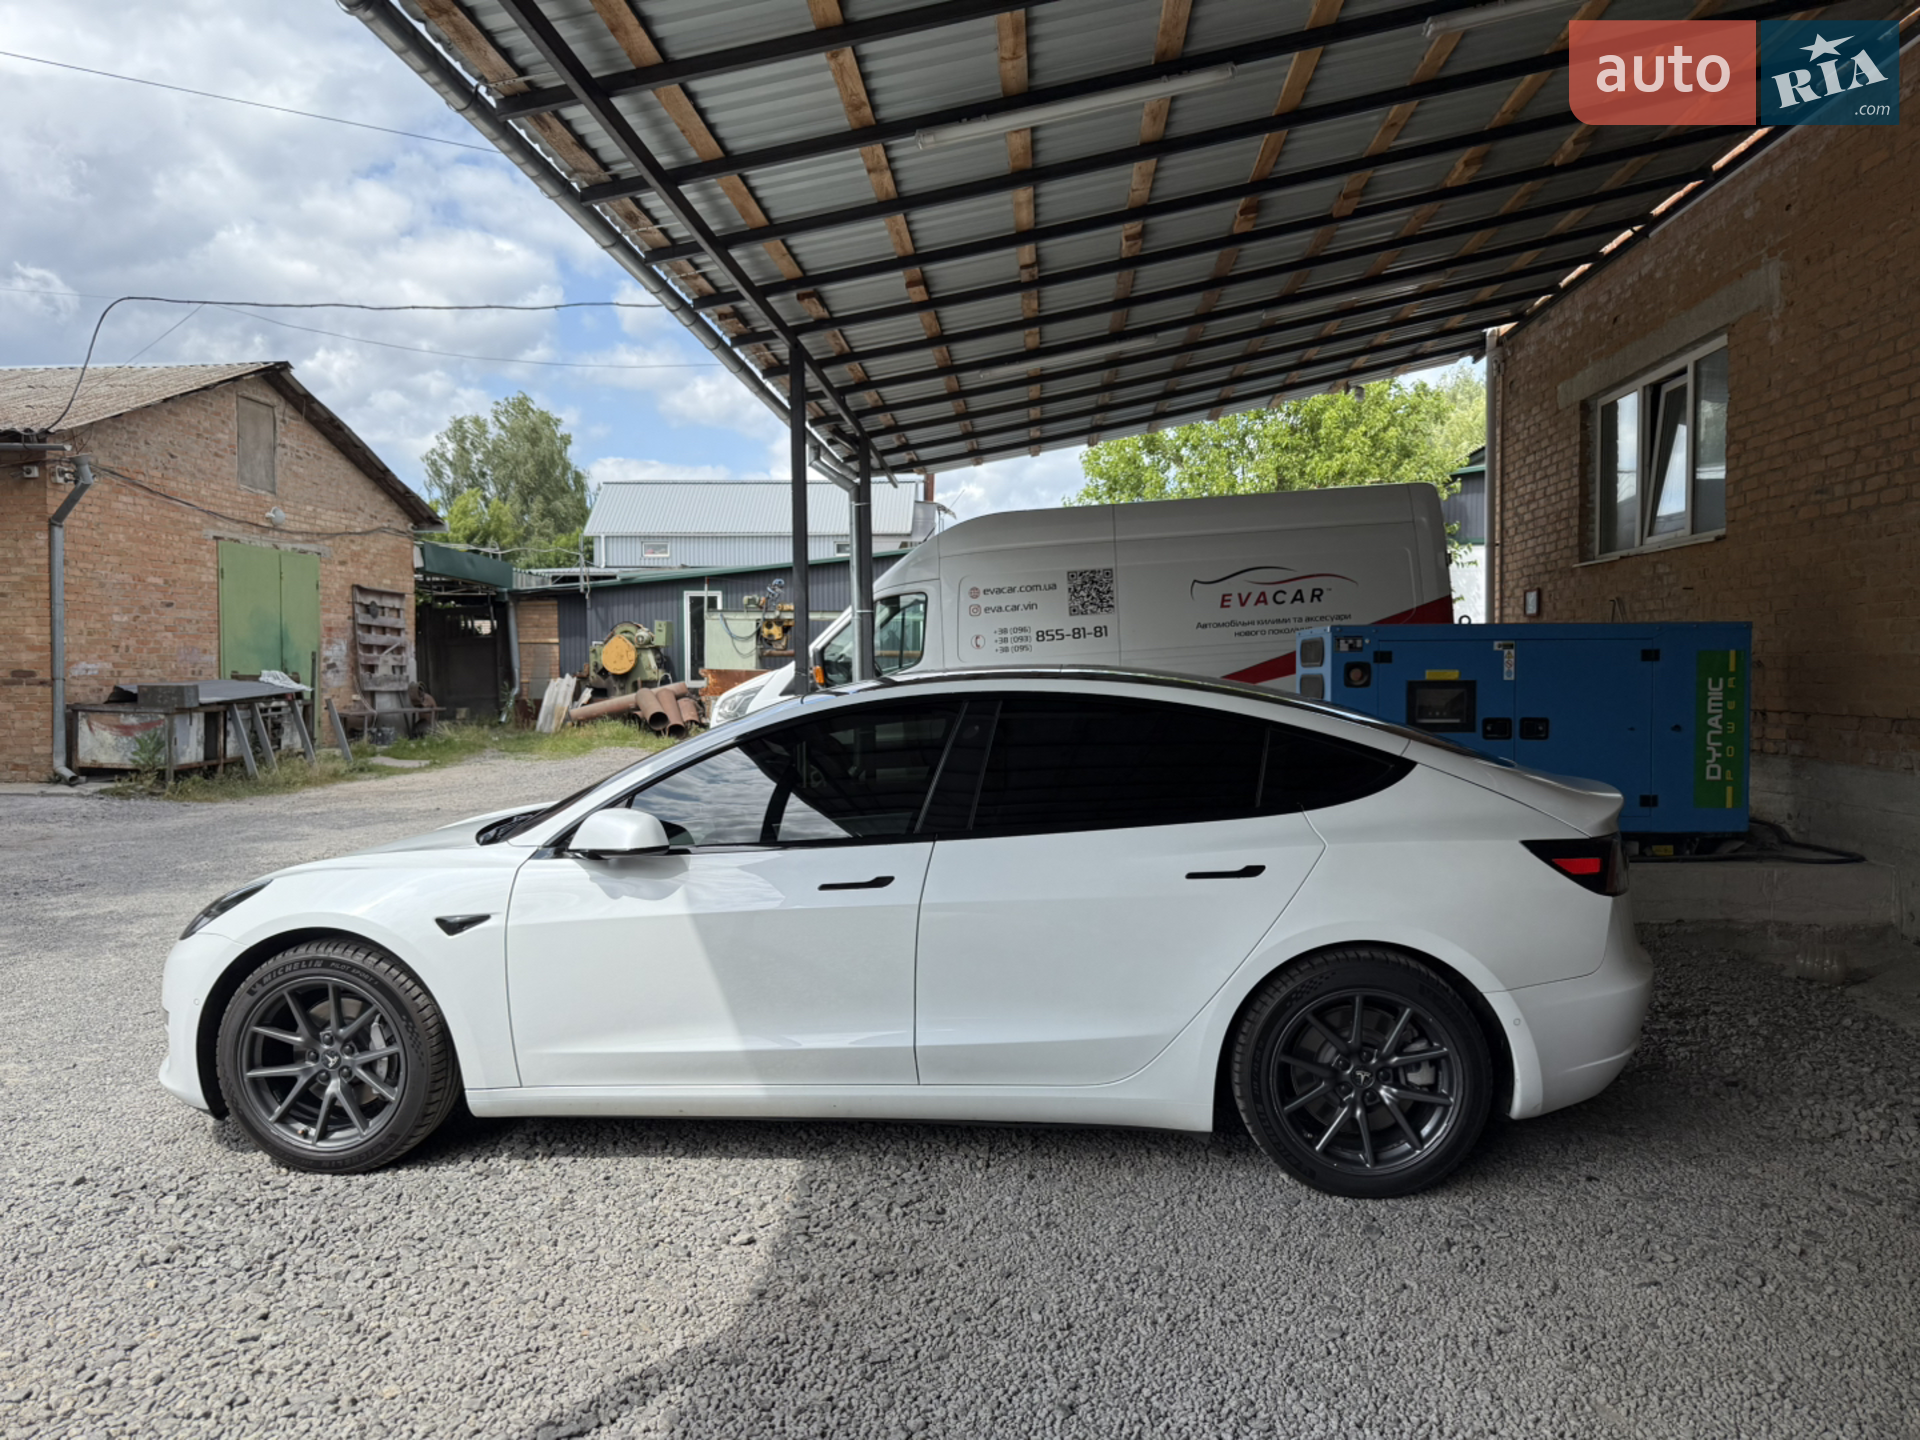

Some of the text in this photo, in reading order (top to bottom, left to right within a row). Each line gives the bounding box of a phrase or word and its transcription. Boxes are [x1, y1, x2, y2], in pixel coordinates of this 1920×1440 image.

[983, 582, 1057, 596] evacar.com.ua
[1219, 587, 1325, 609] EVACAR
[983, 601, 1038, 614] eva.car.vin
[1195, 613, 1352, 630] Автомобільні килими та аксесуари
[993, 625, 1031, 636] +38 (096)
[1035, 625, 1108, 643] 855-81-81
[1234, 629, 1267, 638] нового
[994, 636, 1009, 645] +38
[994, 644, 1033, 654] +38 (095)
[1706, 677, 1724, 781] DYNAMIC
[262, 960, 324, 985] MICHELIN
[329, 962, 352, 972] PILOT
